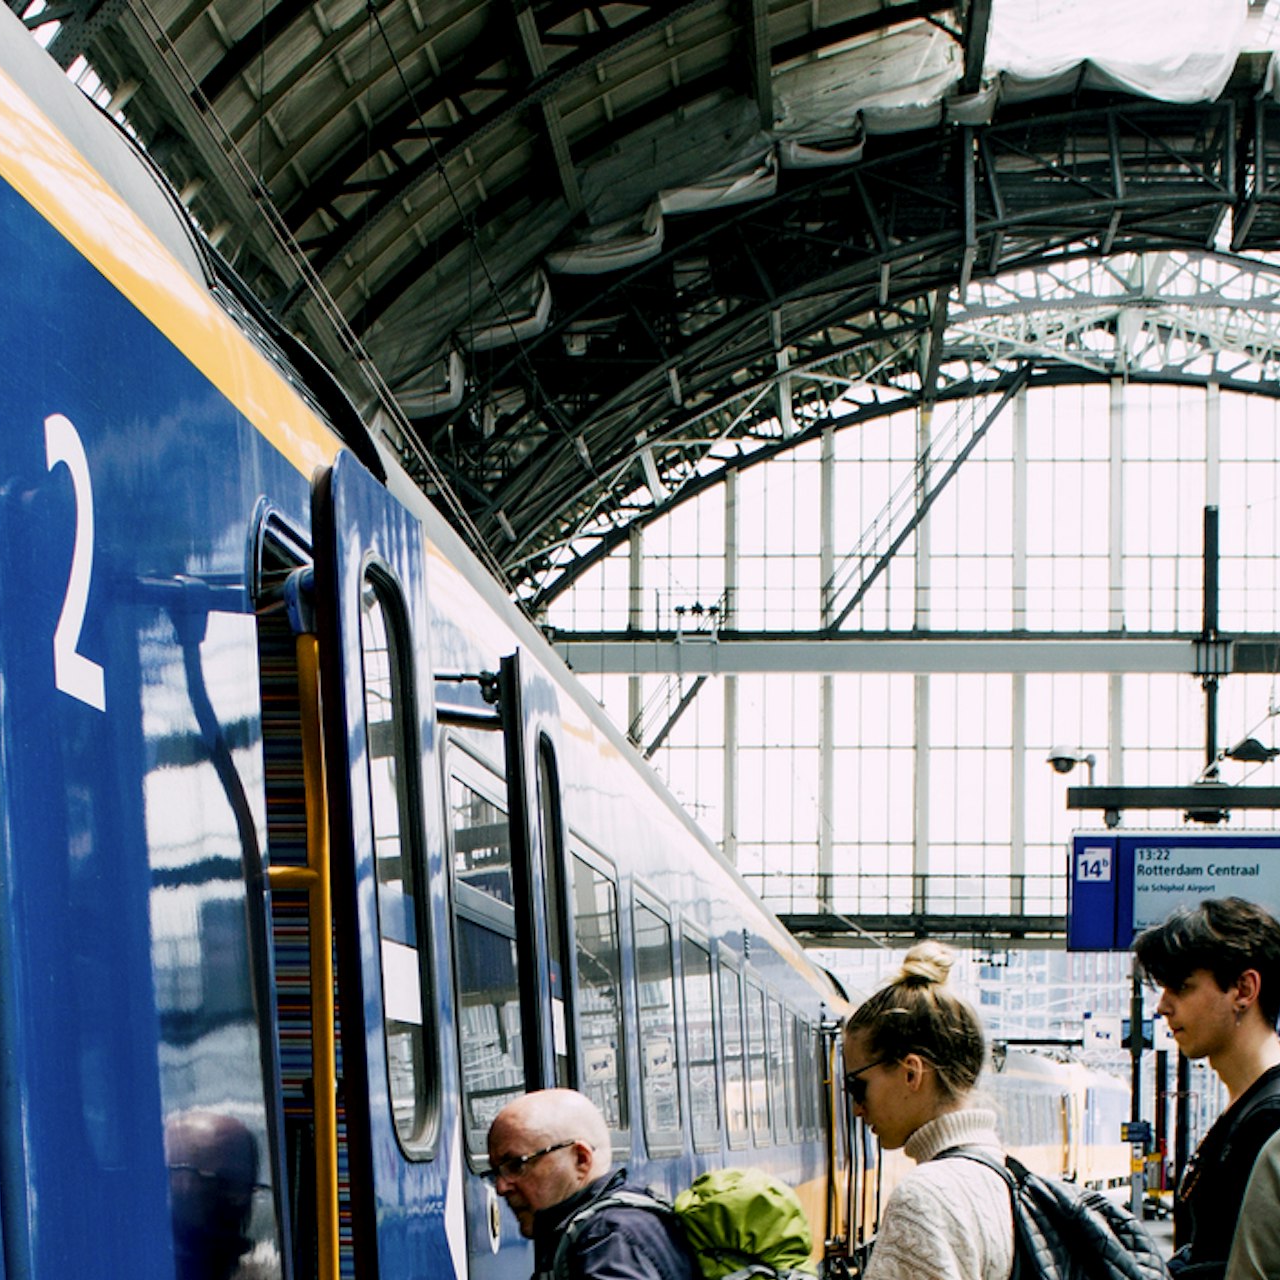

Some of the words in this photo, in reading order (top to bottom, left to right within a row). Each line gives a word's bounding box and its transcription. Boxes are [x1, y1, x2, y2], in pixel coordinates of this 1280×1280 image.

[44, 412, 107, 713] 2
[1138, 849, 1171, 861] 13:22
[1137, 863, 1203, 876] Rotterdam
[1207, 863, 1260, 876] Centraal
[1137, 884, 1149, 892] via
[1152, 884, 1185, 893] Schiphol
[1188, 884, 1216, 893] Airport
